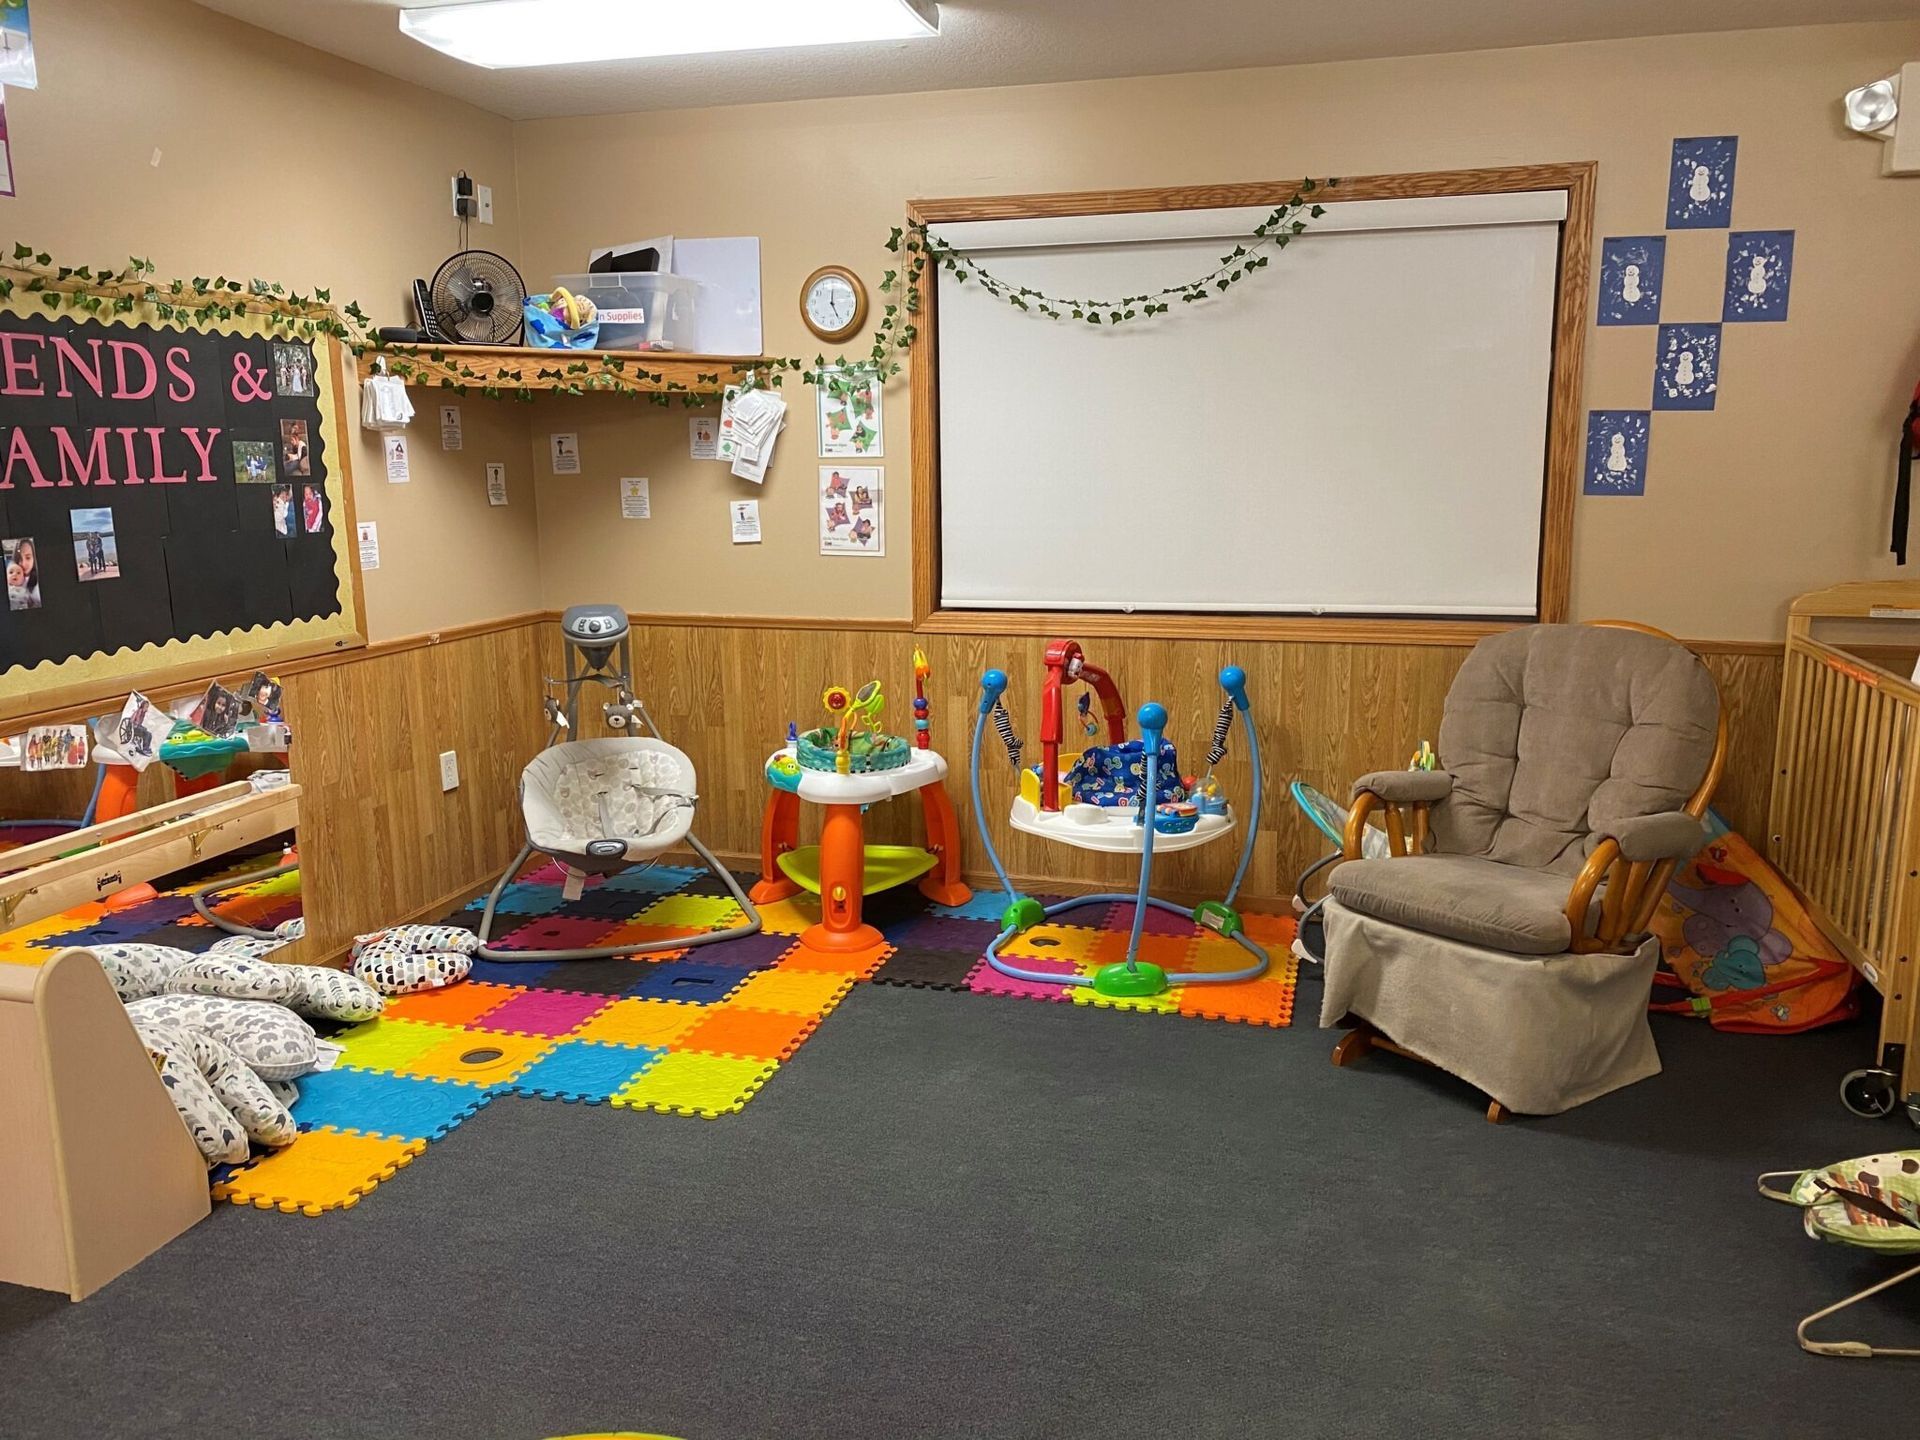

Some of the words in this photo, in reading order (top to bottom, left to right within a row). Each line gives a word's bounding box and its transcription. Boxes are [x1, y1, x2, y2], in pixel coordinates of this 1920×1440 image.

[607, 312, 643, 322] Supplies
[0, 331, 196, 403] ENDS
[231, 351, 273, 404] &
[0, 426, 222, 490] AMILY
